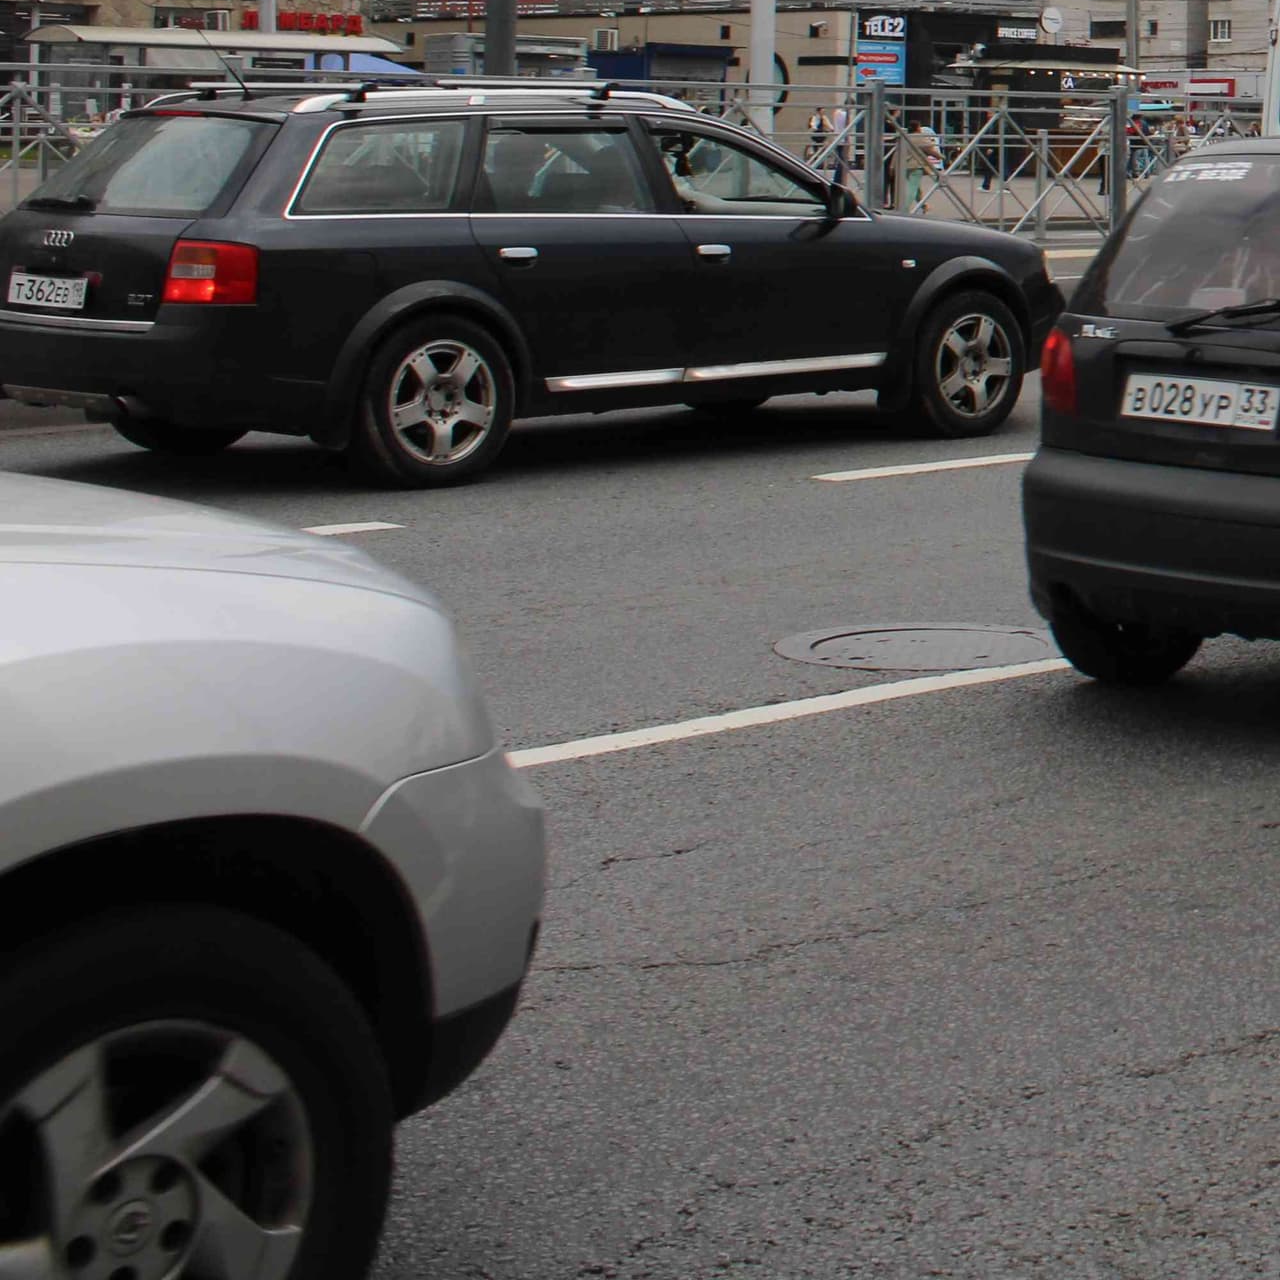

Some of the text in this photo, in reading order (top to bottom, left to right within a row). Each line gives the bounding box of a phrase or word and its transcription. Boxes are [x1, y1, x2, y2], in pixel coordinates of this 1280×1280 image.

[242, 10, 363, 36] ЛМБАРД
[865, 17, 905, 37] TELE2
[16, 279, 69, 303] Т362ЕВ
[1132, 382, 1267, 419] В028УР 33
